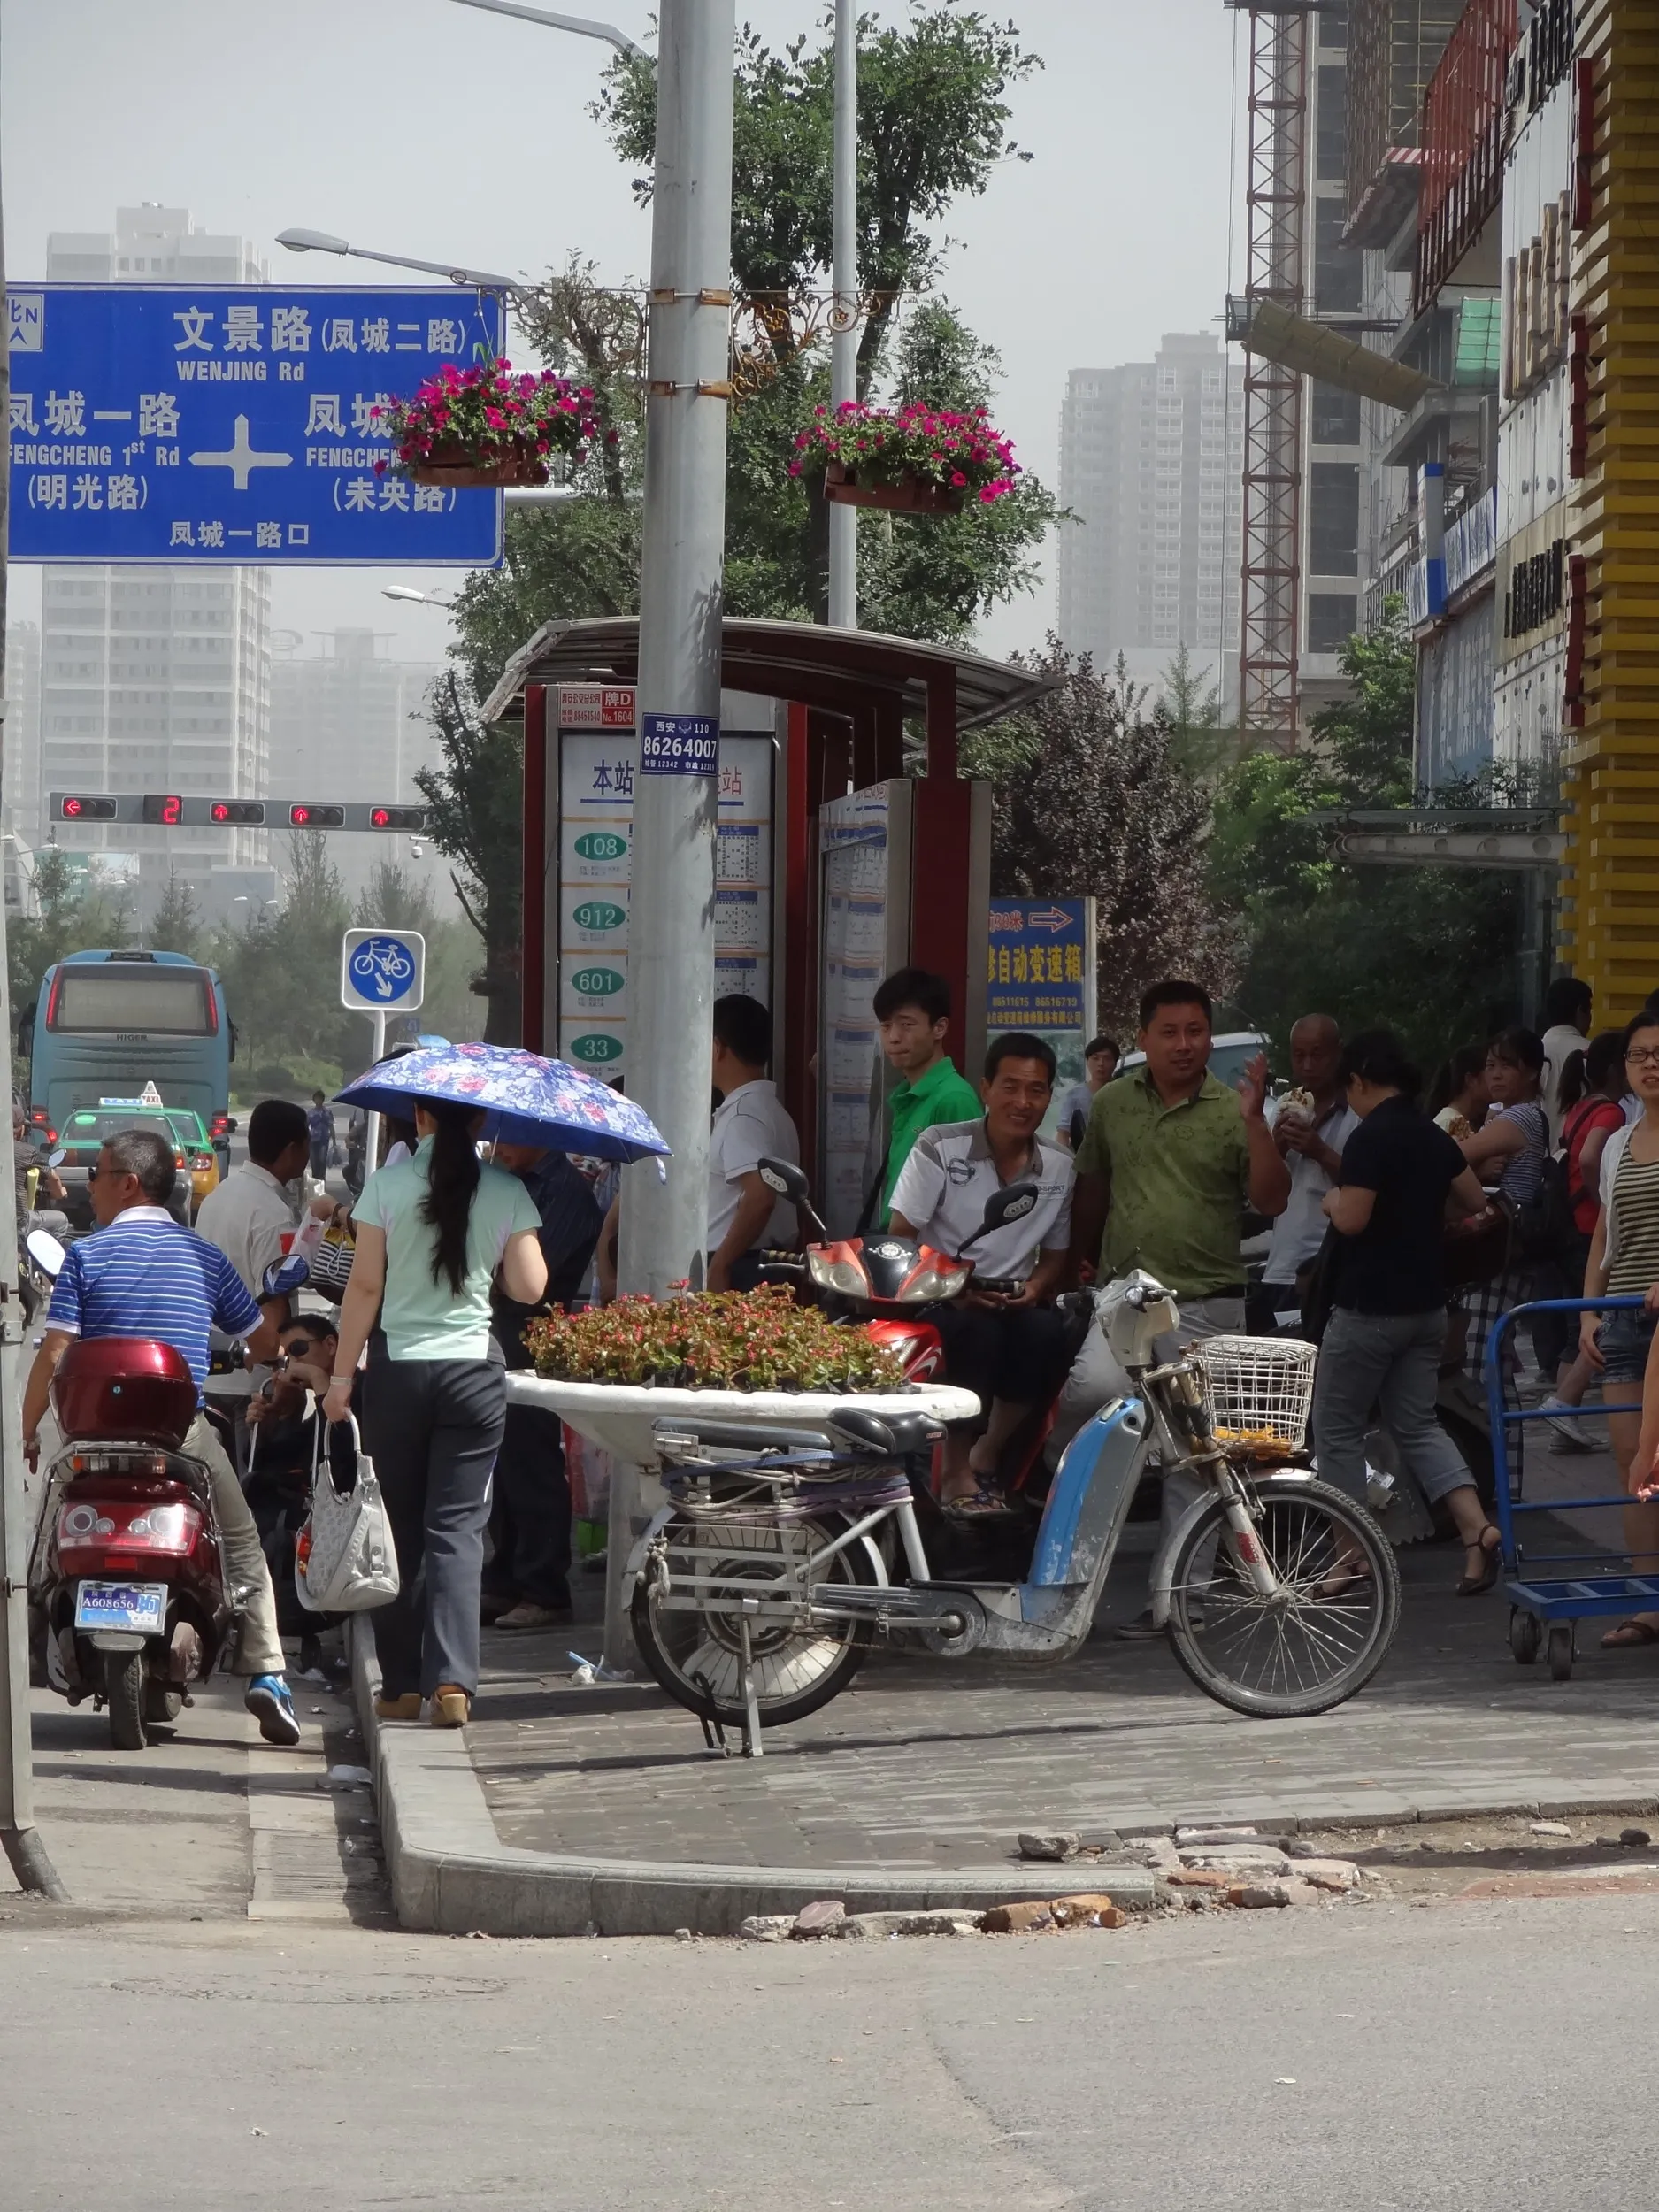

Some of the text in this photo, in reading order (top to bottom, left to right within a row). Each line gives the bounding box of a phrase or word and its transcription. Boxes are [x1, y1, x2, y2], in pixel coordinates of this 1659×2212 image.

[177, 361, 305, 381] WENJING Rd
[9, 390, 180, 437] 凤城一路
[304, 393, 394, 439] 凤城
[155, 446, 180, 466] Rd
[28, 474, 148, 510] (明光路)
[334, 476, 457, 512] (未央路)
[169, 520, 310, 548] 凤城一路口
[656, 721, 710, 734] 西安 110
[643, 735, 717, 759] 86264007
[718, 765, 742, 795] 站
[164, 796, 180, 823] 2
[583, 838, 617, 855] 108
[580, 908, 616, 926] 912
[580, 973, 611, 991] 601
[584, 1039, 608, 1057] 33
[82, 1597, 134, 1609] A608656
